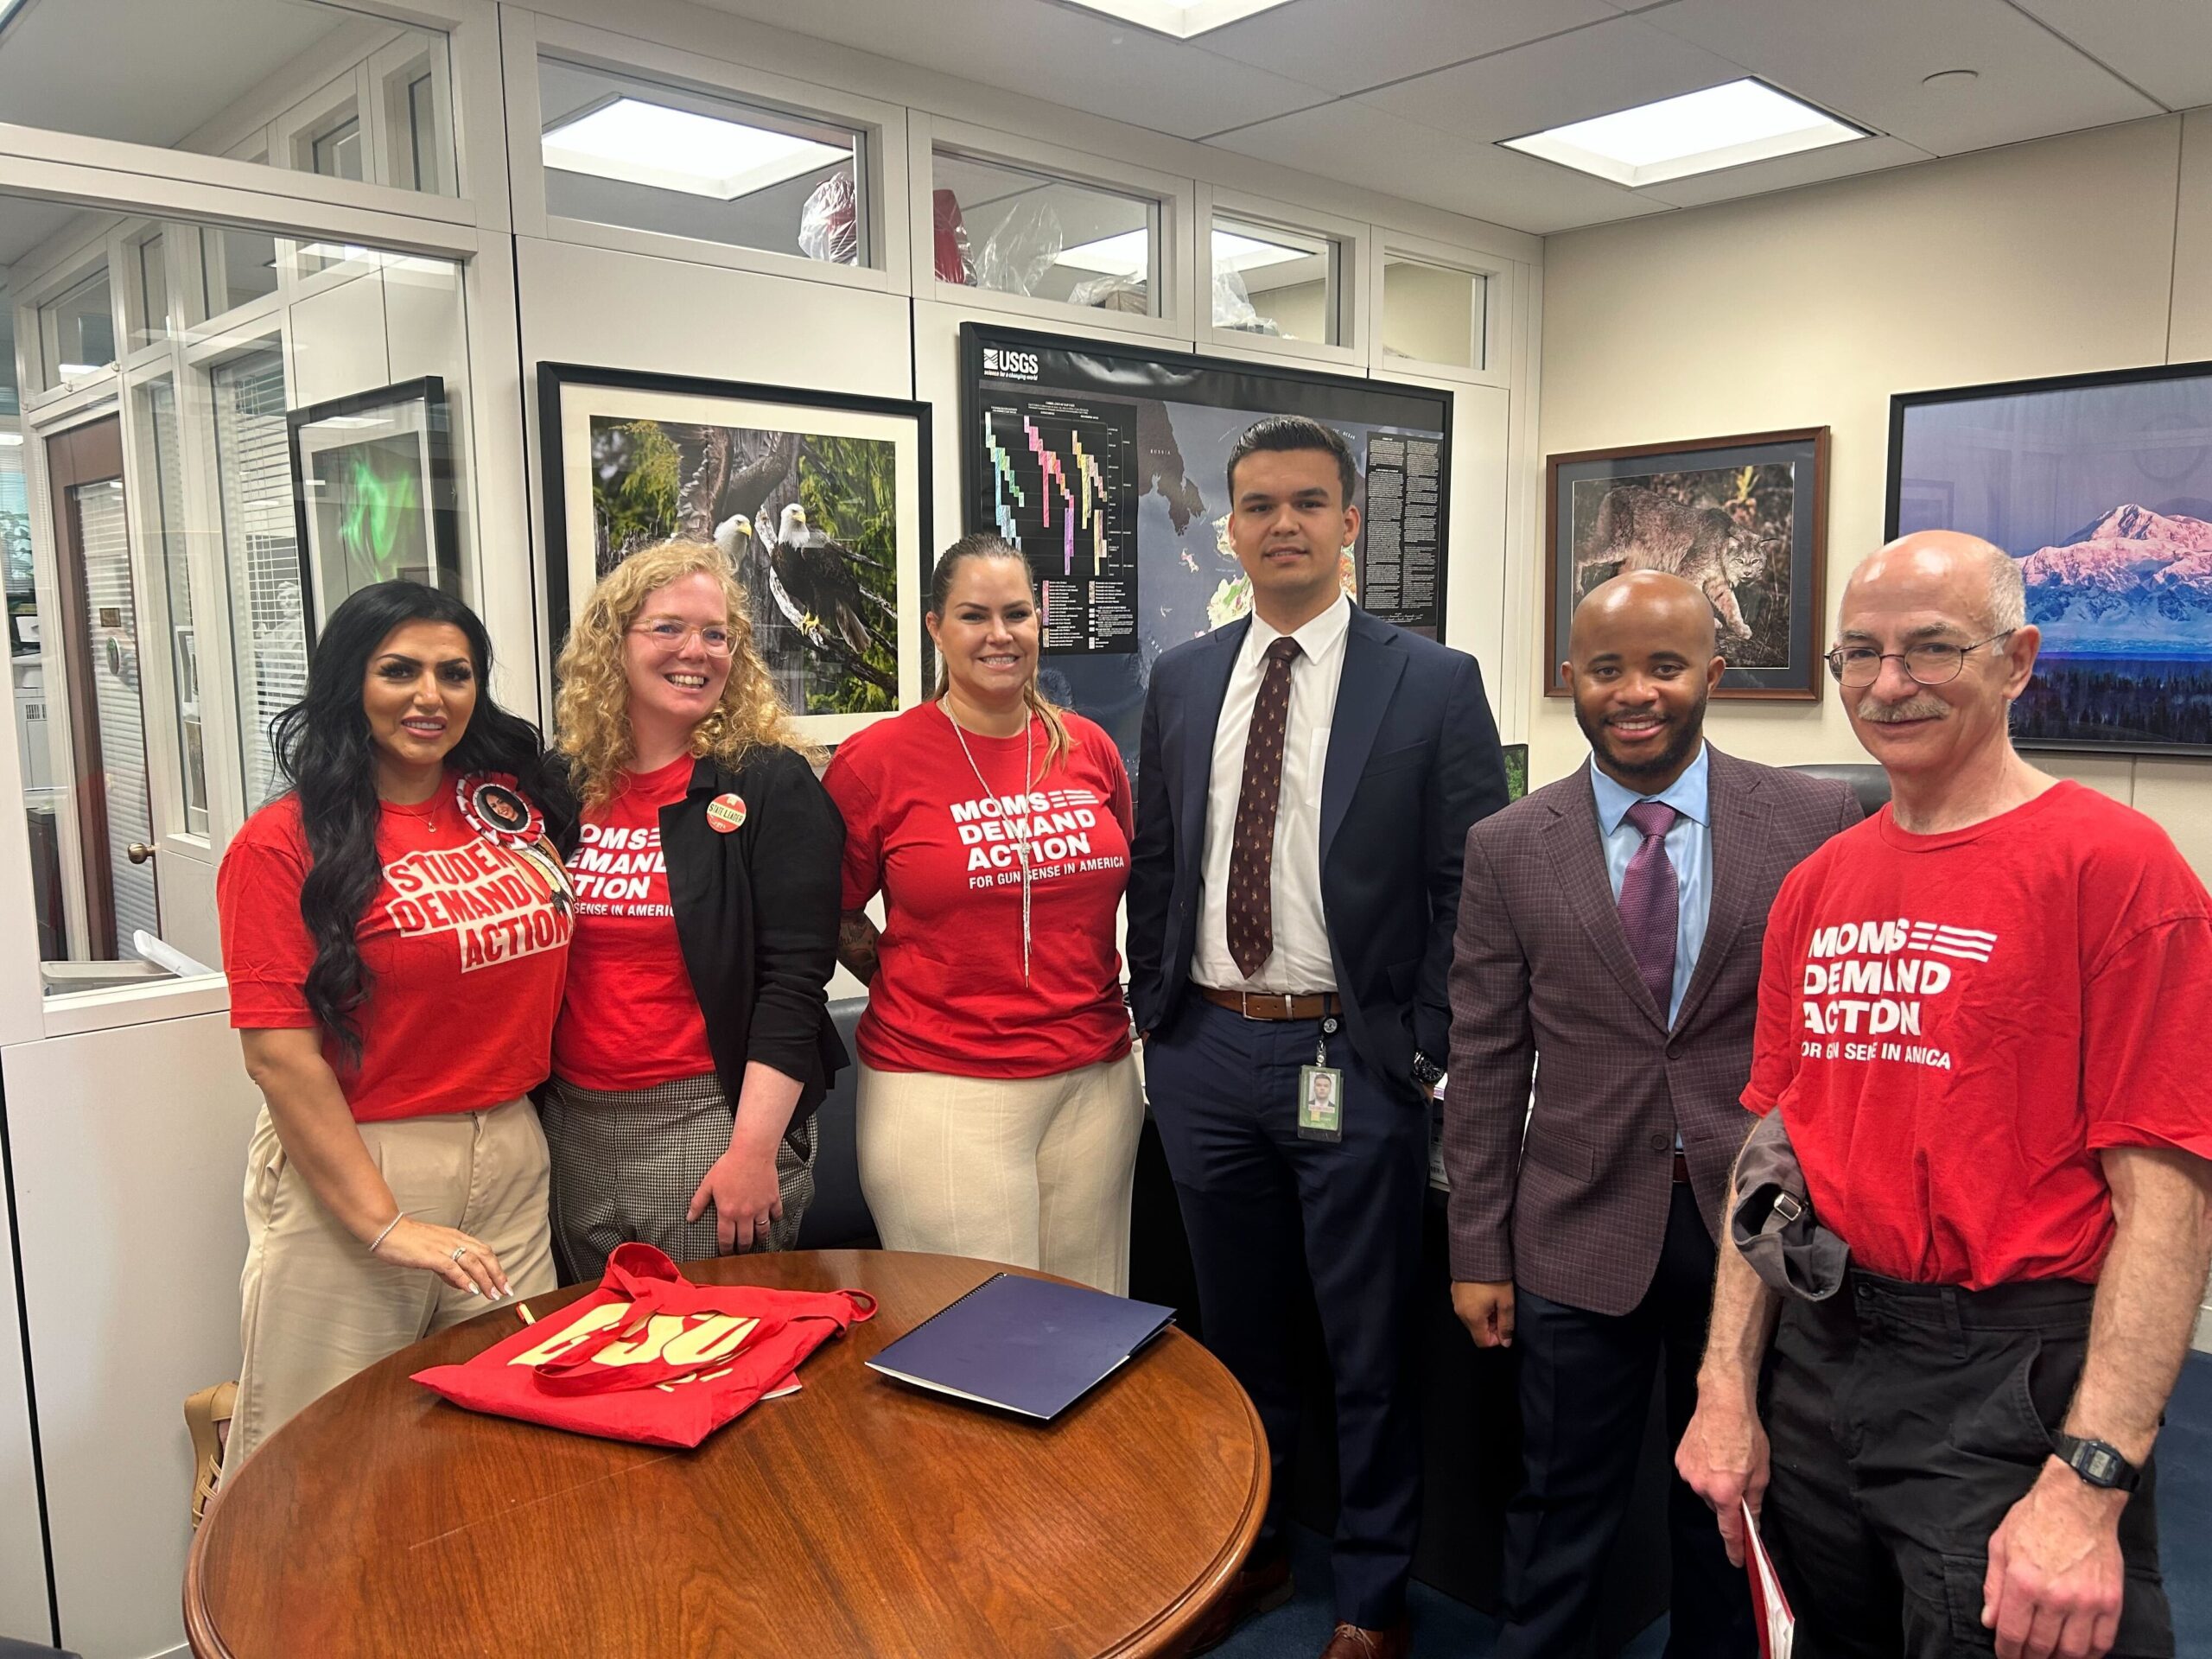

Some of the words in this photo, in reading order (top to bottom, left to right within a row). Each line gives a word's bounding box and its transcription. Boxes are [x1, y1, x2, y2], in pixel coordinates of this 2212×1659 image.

[999, 350, 1039, 374] USGS
[950, 792, 1050, 823] MOMS
[579, 823, 649, 850] OMS
[957, 809, 1096, 845] DEMAND
[390, 839, 517, 893] STUDEN
[565, 848, 666, 874] EMAN
[967, 832, 1091, 871] ACTION
[568, 873, 650, 899] TION
[969, 874, 993, 889] FOR
[997, 870, 1020, 886] GUN
[1027, 867, 1060, 881] SENSE
[1064, 862, 1075, 874] IN
[1079, 856, 1124, 872] AMERICA
[391, 874, 531, 932] DEMAND
[574, 902, 607, 916] SENSE
[611, 905, 624, 916] IN
[627, 905, 674, 917] AMERI
[466, 908, 569, 969] ACTION
[1808, 918, 1910, 958] MOMS
[1802, 1041, 1822, 1058] OR
[1881, 1043, 1901, 1061] IN
